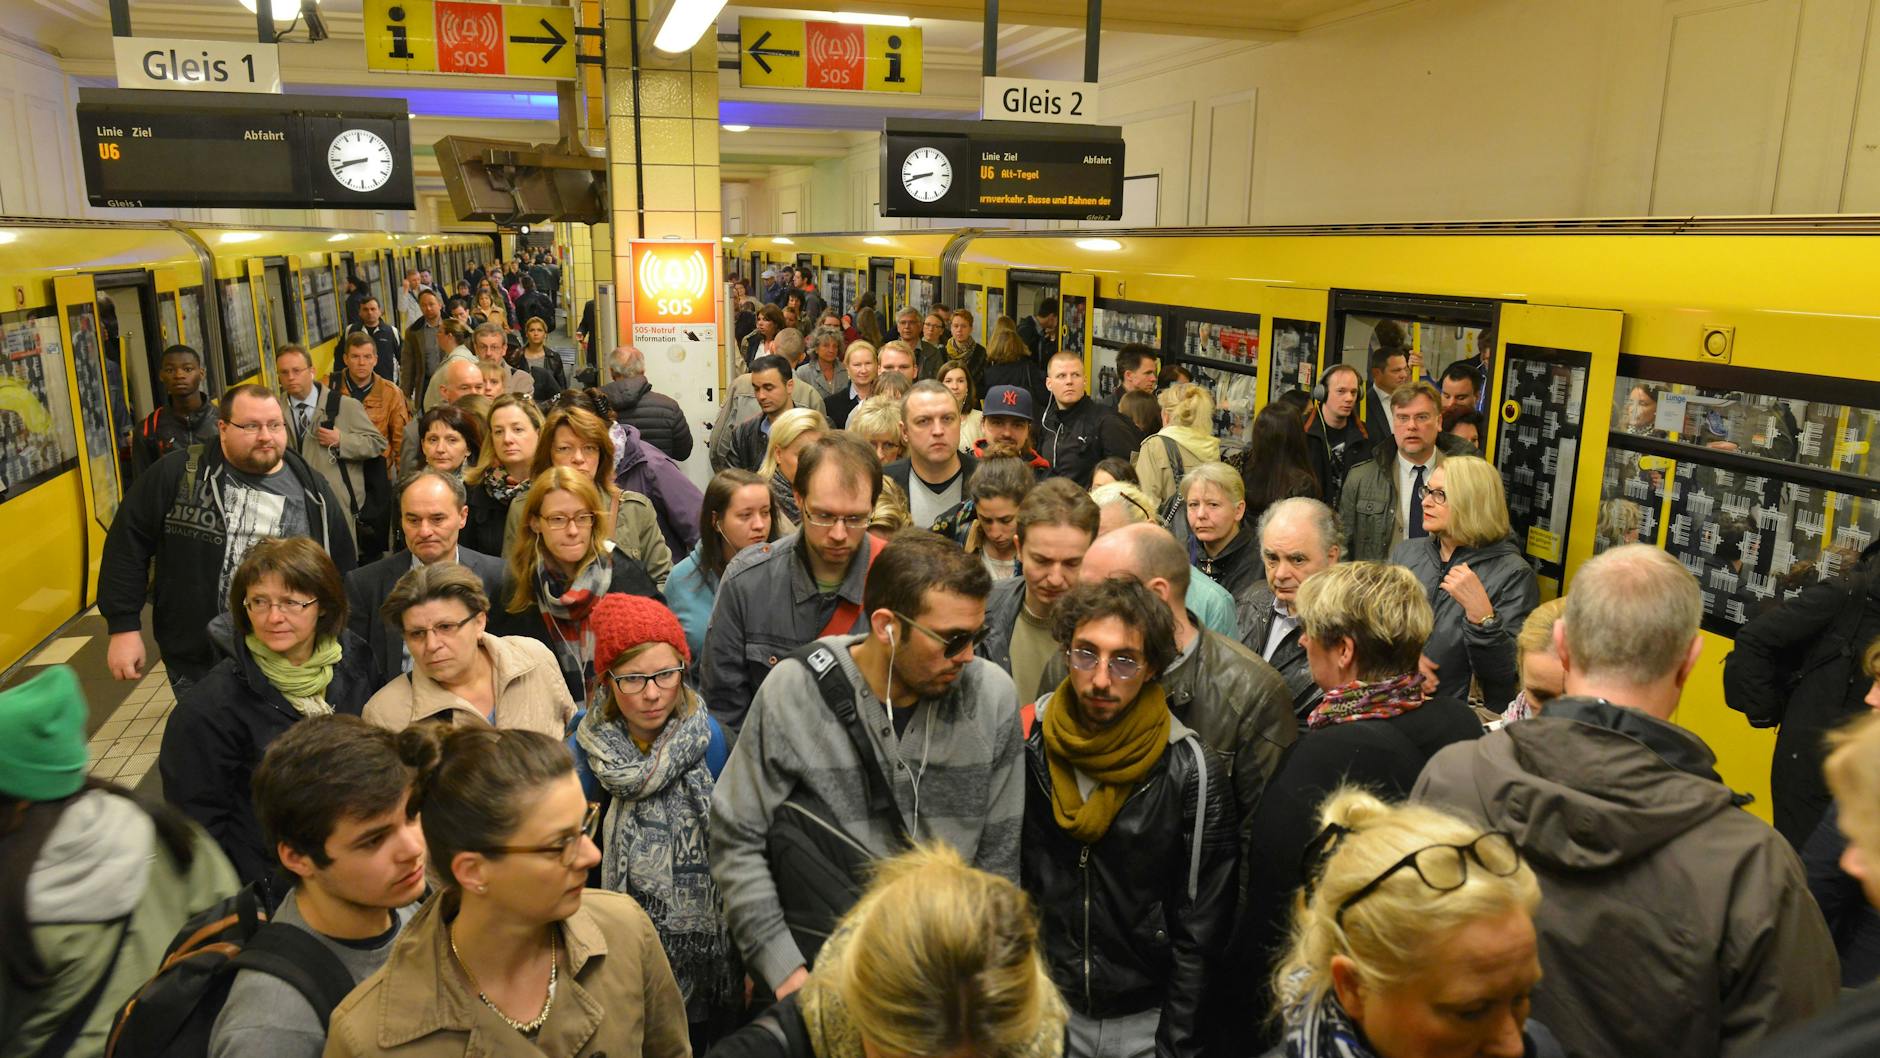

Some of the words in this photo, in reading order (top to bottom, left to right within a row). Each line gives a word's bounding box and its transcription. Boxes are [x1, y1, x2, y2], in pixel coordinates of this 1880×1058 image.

[143, 49, 229, 82] Gleis
[241, 54, 255, 83] 1
[454, 51, 489, 67] SOS
[820, 68, 850, 84] SOS
[1002, 87, 1062, 115] Gleis
[1070, 92, 1083, 116] 2
[97, 126, 124, 137] Linie
[131, 127, 153, 138] Ziel
[244, 130, 285, 141] Abfahrt
[98, 143, 121, 160] U6
[982, 152, 1001, 161] Linie
[1003, 152, 1018, 161] Ziel
[1083, 155, 1112, 165] Abfahrt
[980, 165, 995, 180] U6
[1001, 169, 1040, 181] Alt-Tegel
[107, 199, 135, 208] Gleis
[137, 200, 143, 208] 1
[1027, 195, 1051, 205] Busse
[1052, 195, 1067, 205] und
[1068, 195, 1098, 205] Bahnen
[1098, 196, 1112, 206] der
[657, 298, 693, 316] SOS
[634, 326, 676, 335] SOS-Notruf
[635, 335, 676, 343] Information
